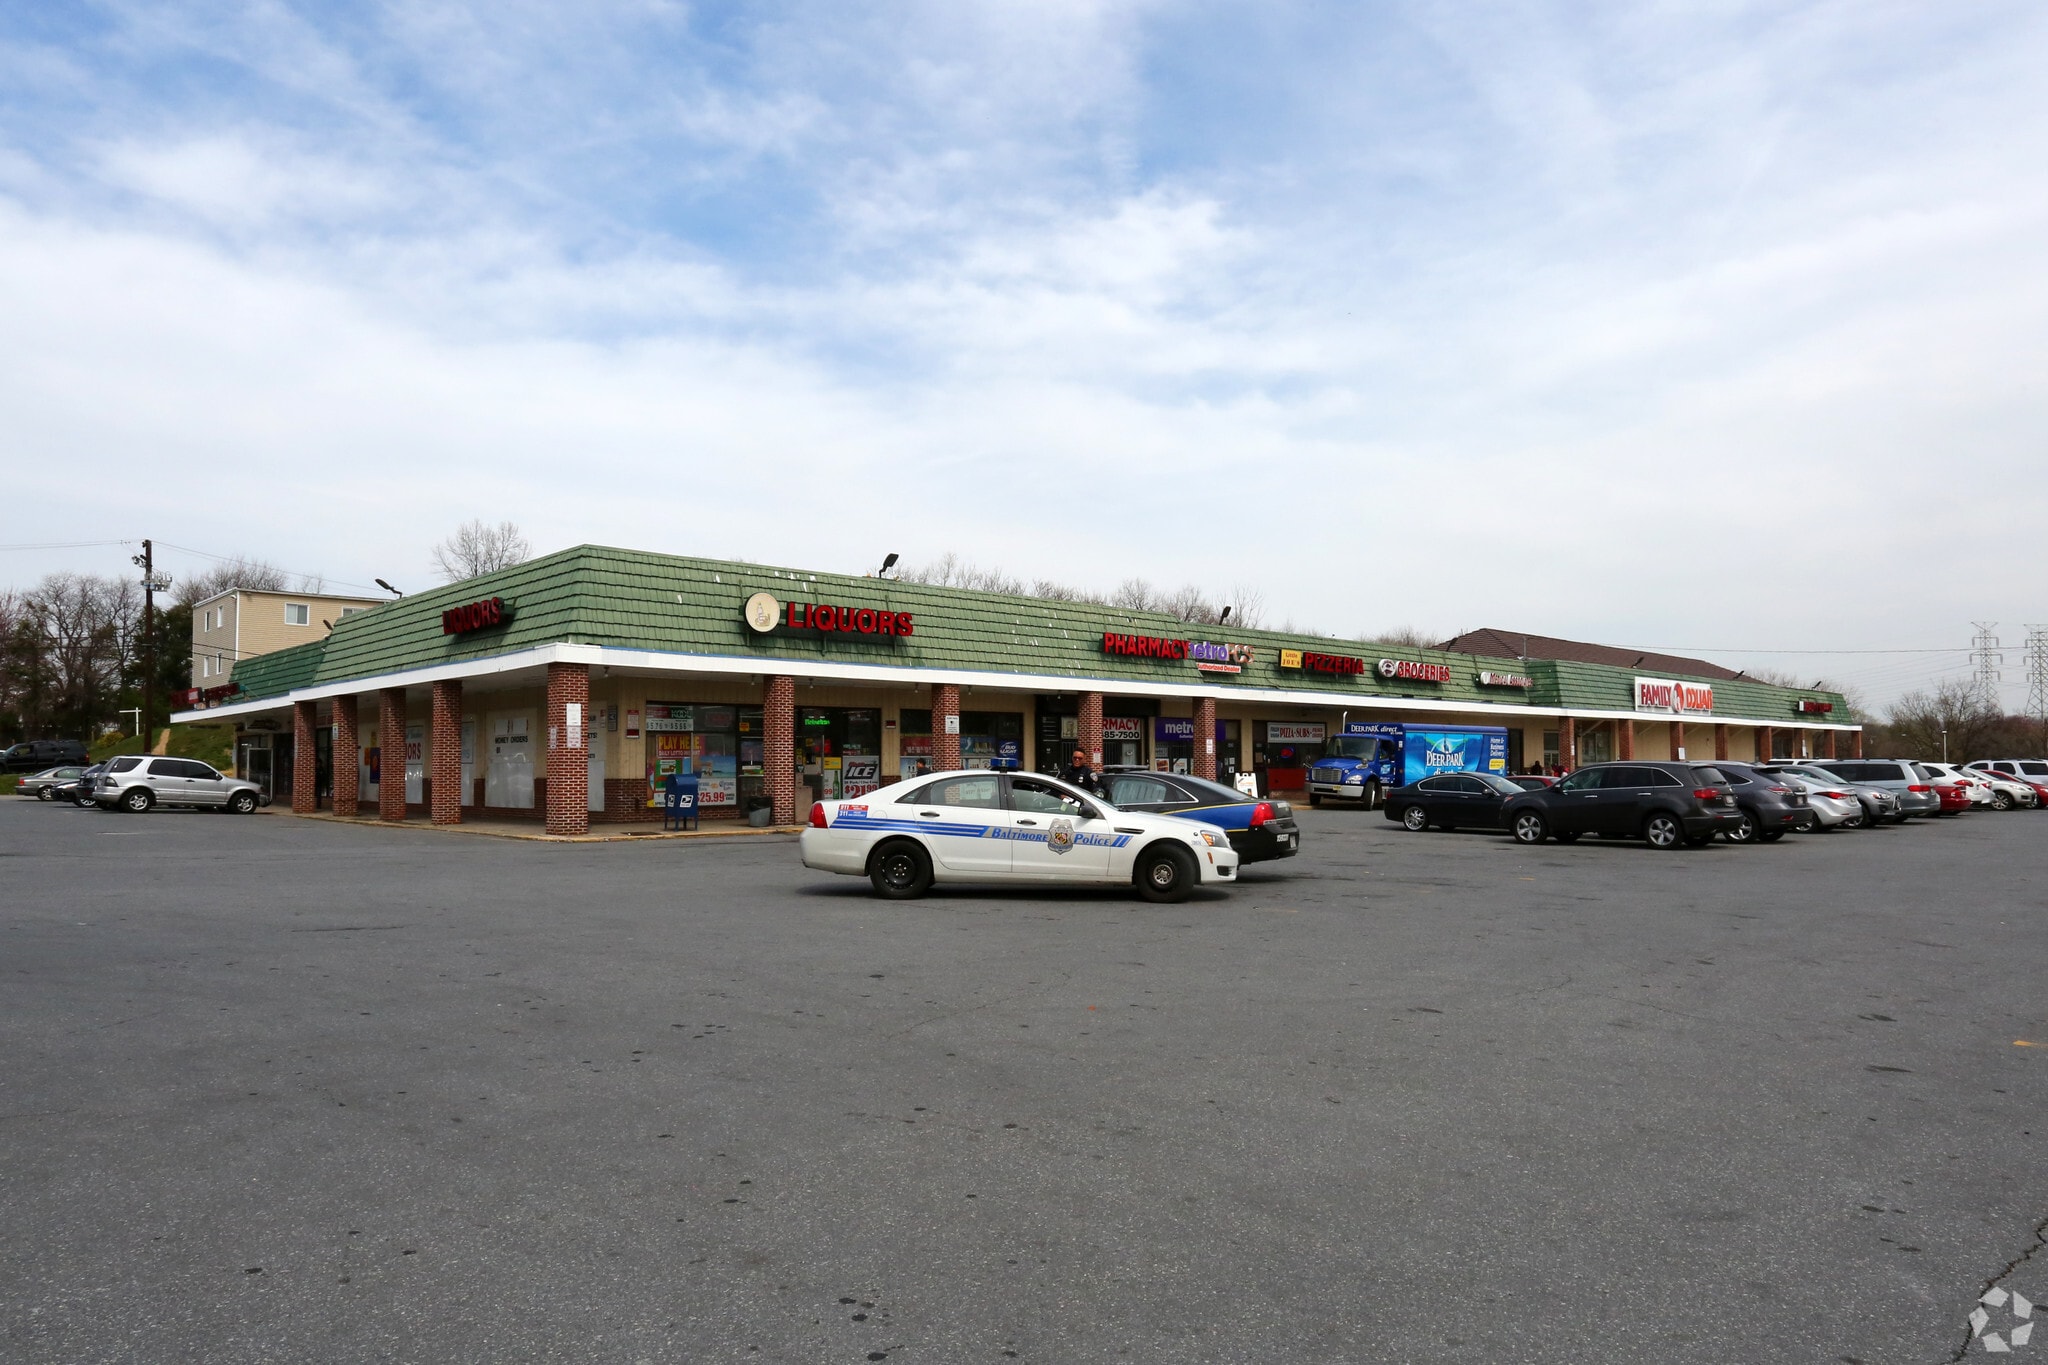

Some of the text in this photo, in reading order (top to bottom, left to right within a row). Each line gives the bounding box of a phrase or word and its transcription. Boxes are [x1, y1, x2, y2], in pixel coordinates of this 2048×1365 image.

[442, 597, 502, 635] LIQUORS
[787, 601, 914, 637] LIQUORS
[1104, 632, 1190, 660] PHARMACY
[1303, 651, 1364, 675] PIZZERIA
[1397, 660, 1450, 681] GROCERIES
[1640, 683, 1673, 707] FAMILY
[1102, 718, 1139, 731] RMACY
[1351, 724, 1365, 732] DEER
[1365, 724, 1379, 733] PARK
[510, 735, 528, 743] ORDERS
[658, 735, 702, 750] PLAY HEE.
[1103, 731, 1140, 739] 85-7500
[1426, 751, 1465, 767] DEER PARK
[847, 765, 875, 777] ICE
